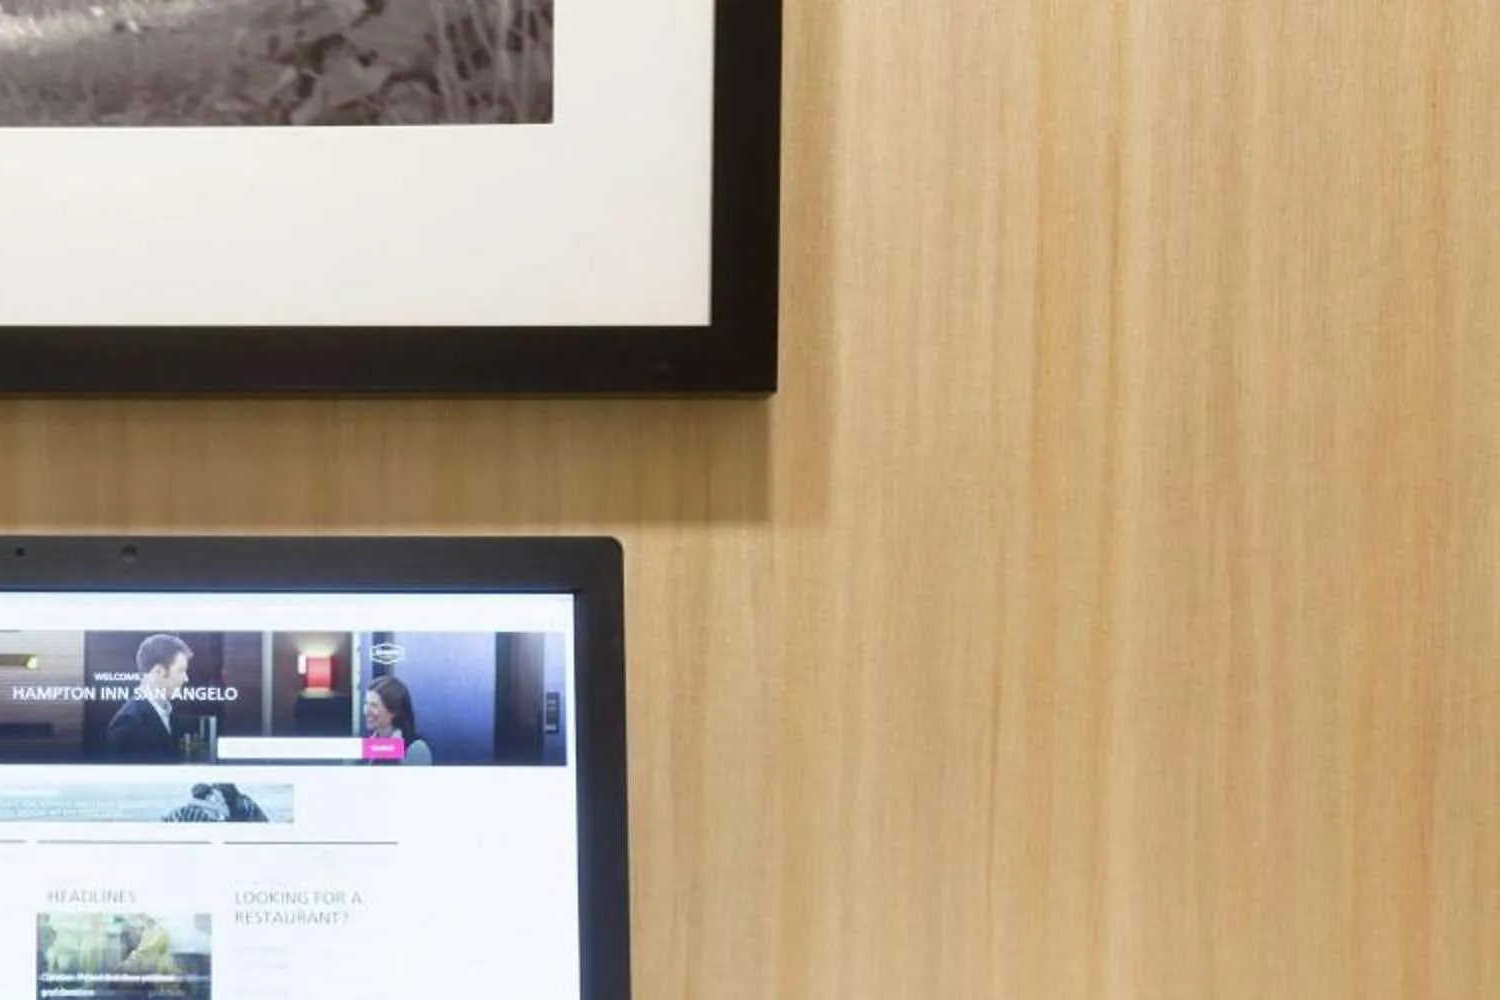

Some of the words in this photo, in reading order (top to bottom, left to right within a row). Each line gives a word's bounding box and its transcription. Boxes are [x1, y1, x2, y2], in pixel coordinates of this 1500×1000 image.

[94, 672, 140, 682] WELCOME
[12, 687, 95, 701] HAMPTON
[101, 687, 129, 701] INN
[134, 687, 166, 701] SAN
[171, 687, 238, 701] ANGELO
[47, 890, 136, 903] HEADLINES
[235, 891, 308, 905] LOOKING
[314, 891, 345, 905] FOR
[351, 891, 362, 905] A
[235, 911, 348, 925] RESTAURANT?
